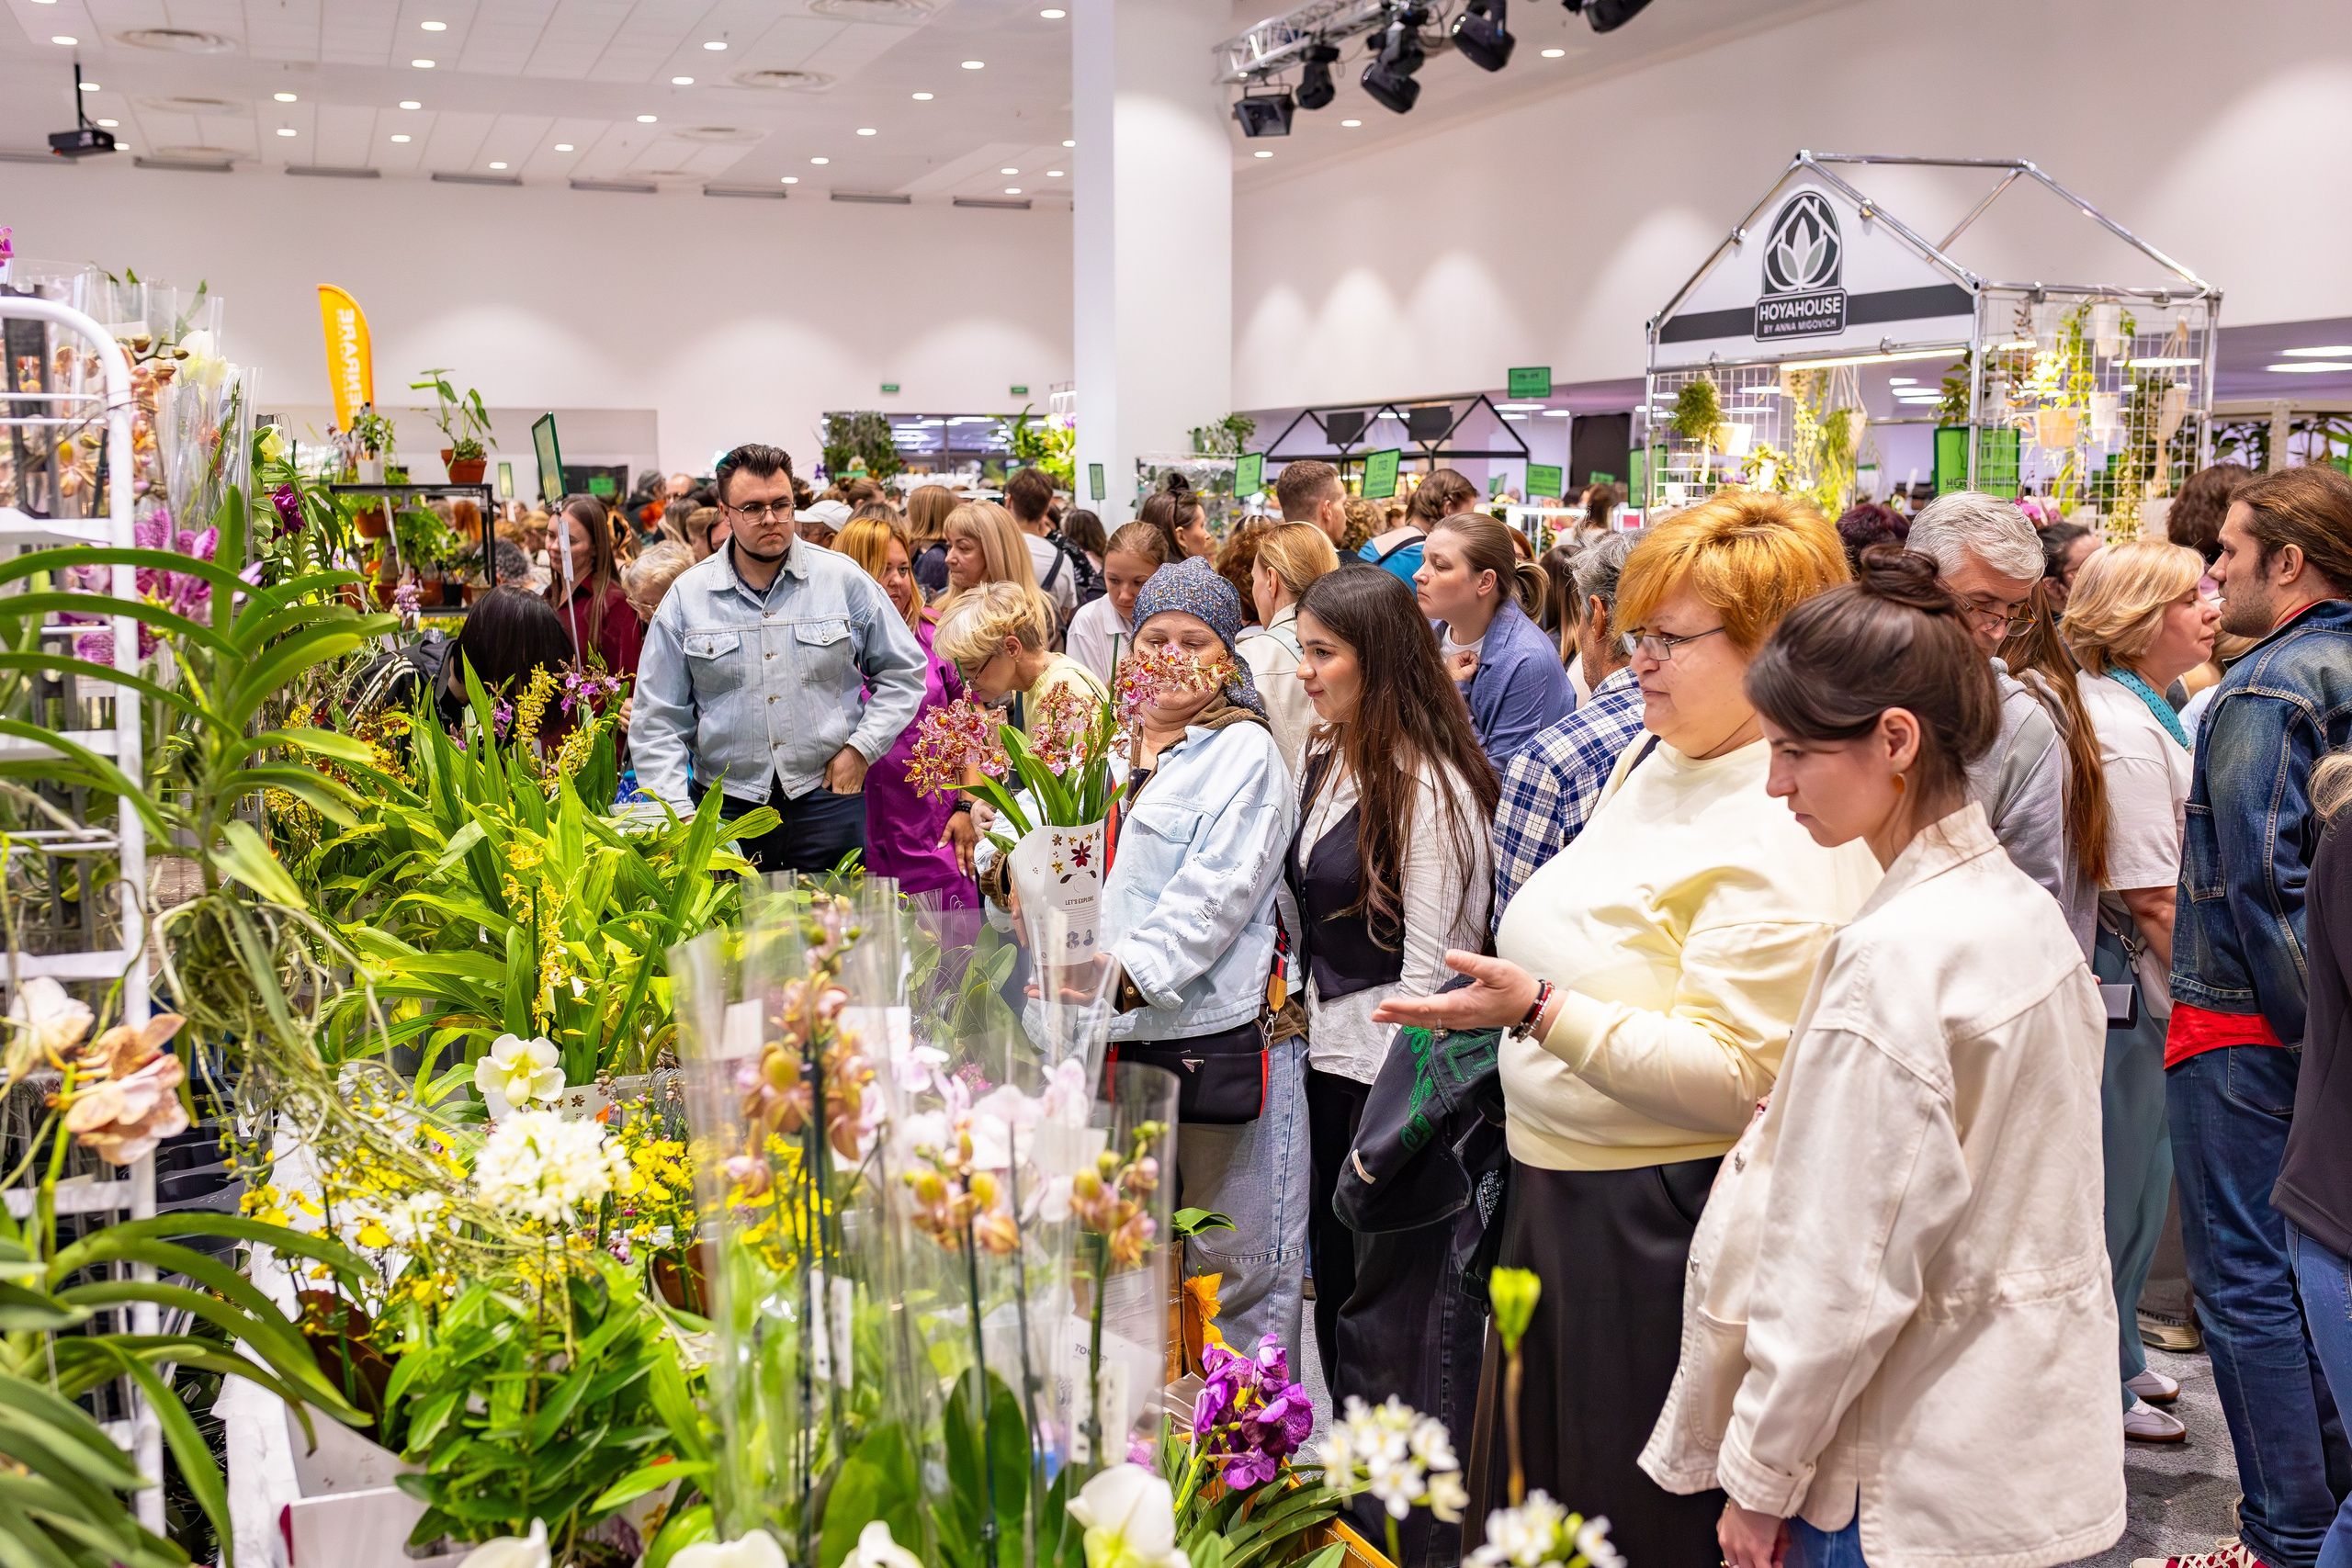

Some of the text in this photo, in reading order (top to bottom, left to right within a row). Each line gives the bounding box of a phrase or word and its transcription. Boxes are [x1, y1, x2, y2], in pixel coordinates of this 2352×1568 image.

[1759, 297, 1841, 321] HOYAHOUSE
[1764, 324, 1773, 333] BY
[1775, 321, 1796, 332] ANNA
[1079, 896, 1094, 904] EXPLORE
